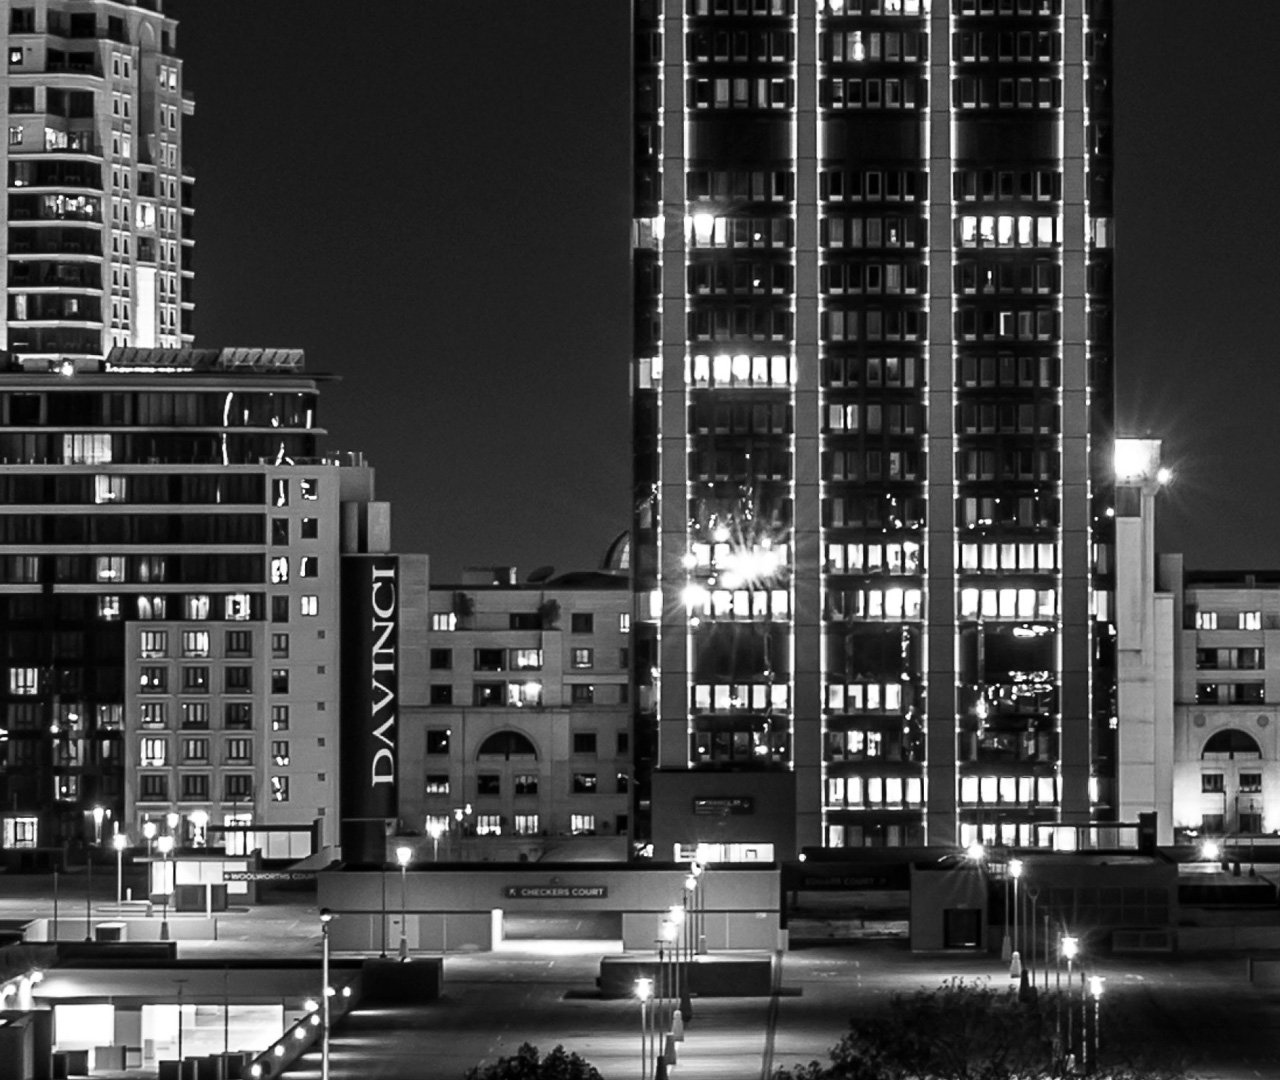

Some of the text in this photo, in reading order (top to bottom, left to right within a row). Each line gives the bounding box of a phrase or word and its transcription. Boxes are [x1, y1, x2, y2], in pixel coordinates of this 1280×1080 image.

[372, 565, 396, 787] DAVINCI
[231, 872, 318, 881] WOOLWORTHS COUR
[521, 888, 604, 896] CHECKERS COURT
